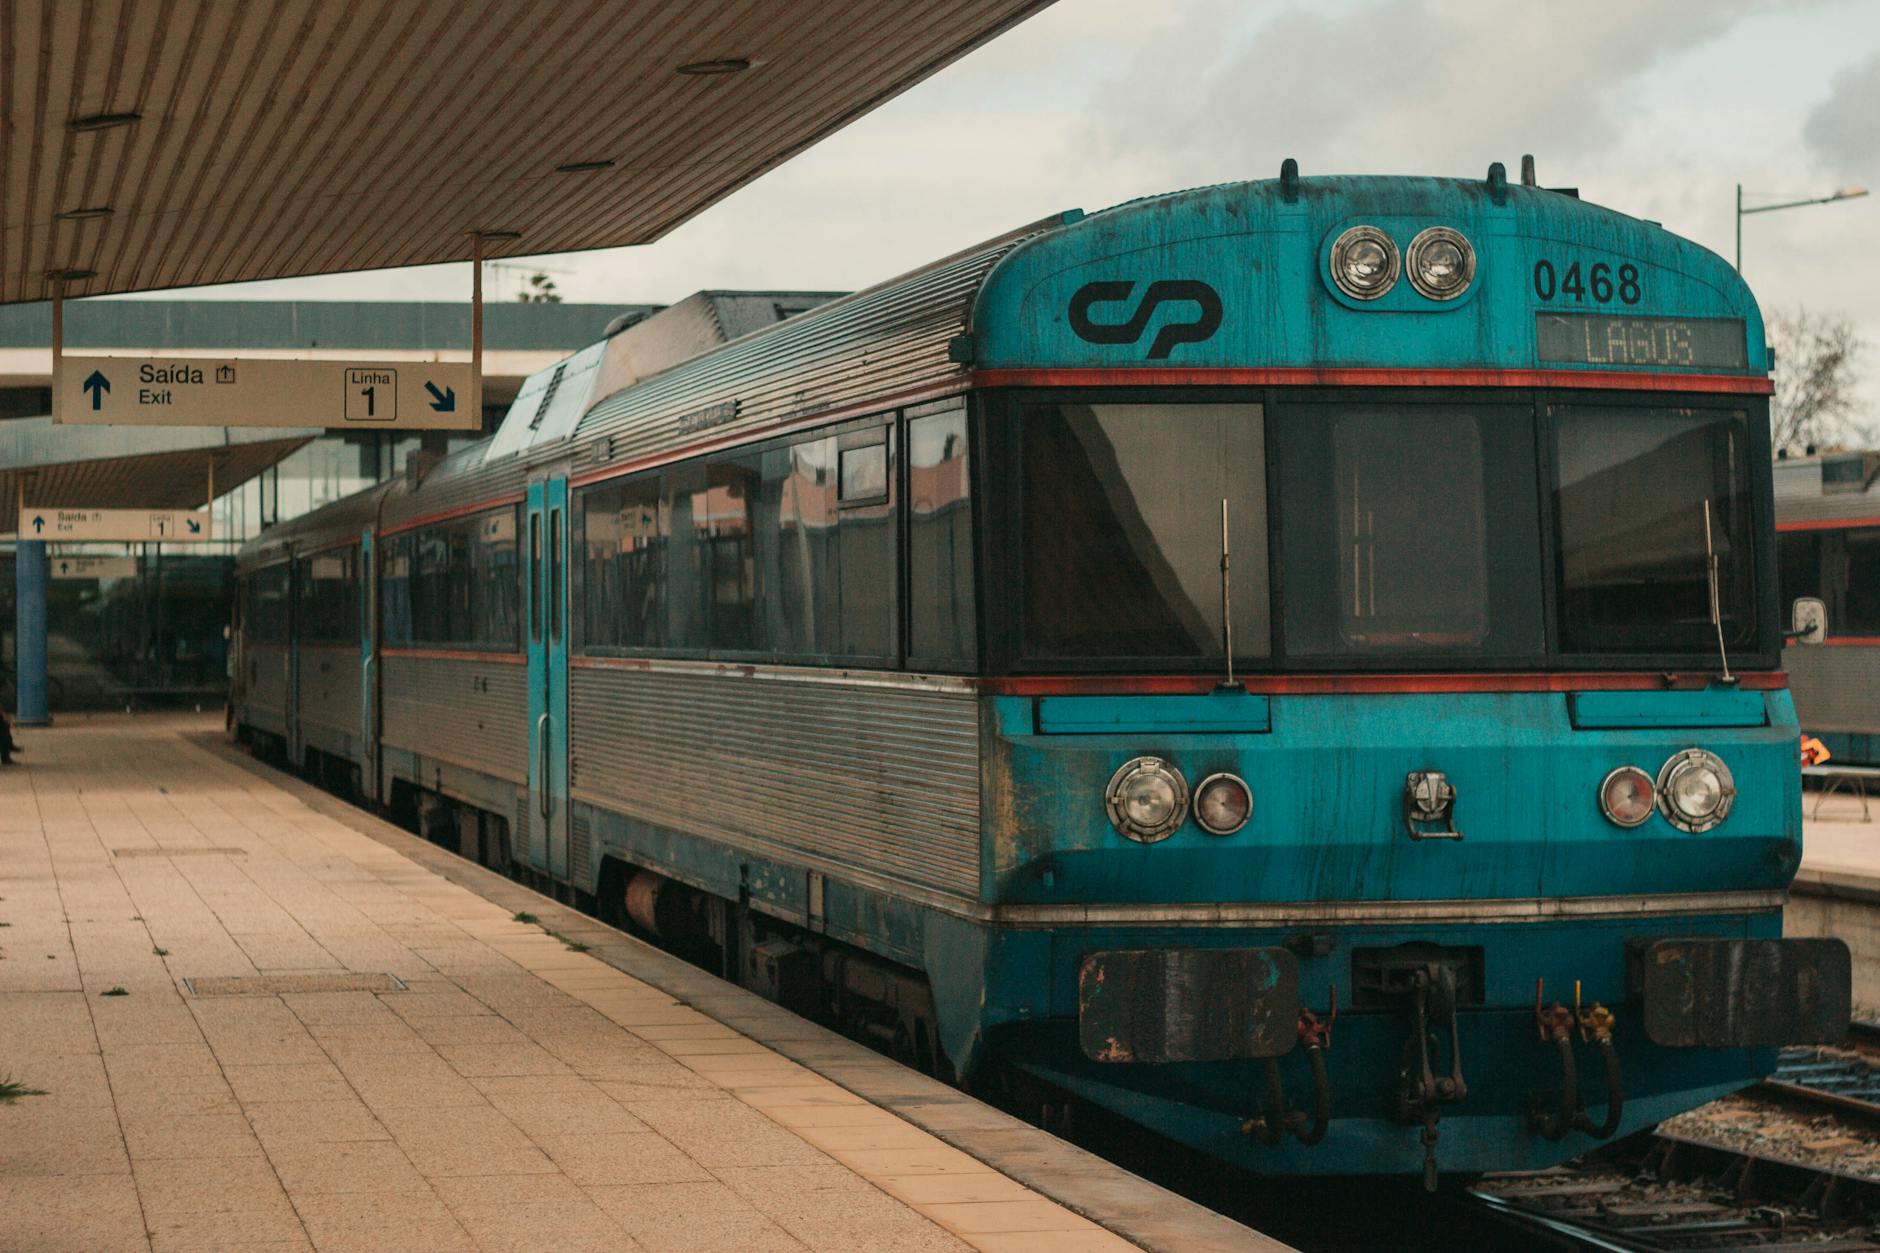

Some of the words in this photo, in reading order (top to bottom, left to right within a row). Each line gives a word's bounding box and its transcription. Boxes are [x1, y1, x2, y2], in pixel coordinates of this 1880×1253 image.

[1534, 259, 1642, 305] 0468
[139, 364, 204, 385] Saída
[352, 371, 390, 385] Linha
[139, 389, 172, 405] Exit
[361, 386, 375, 417] 1
